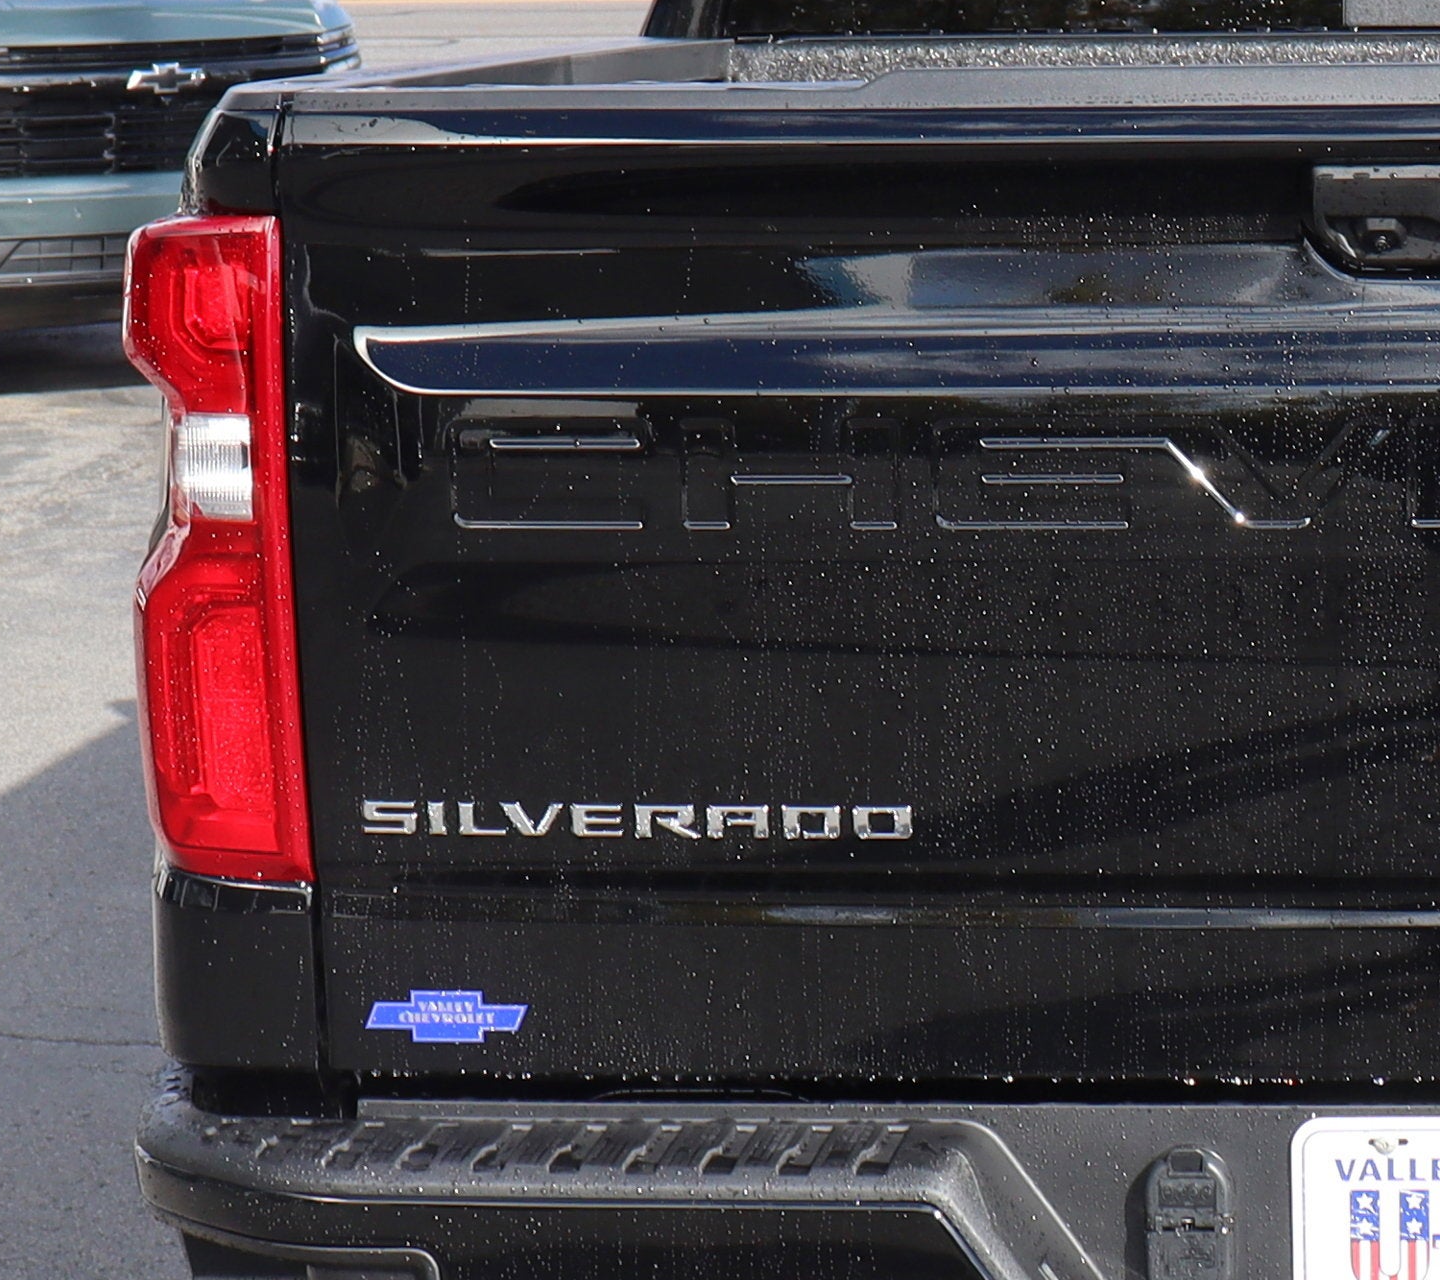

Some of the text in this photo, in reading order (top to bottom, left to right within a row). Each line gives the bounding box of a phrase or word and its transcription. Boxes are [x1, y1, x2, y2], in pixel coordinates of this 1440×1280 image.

[361, 800, 914, 840] SILVERADO
[417, 1001, 475, 1013] VALLEY
[397, 1012, 496, 1024] CHEVROLET
